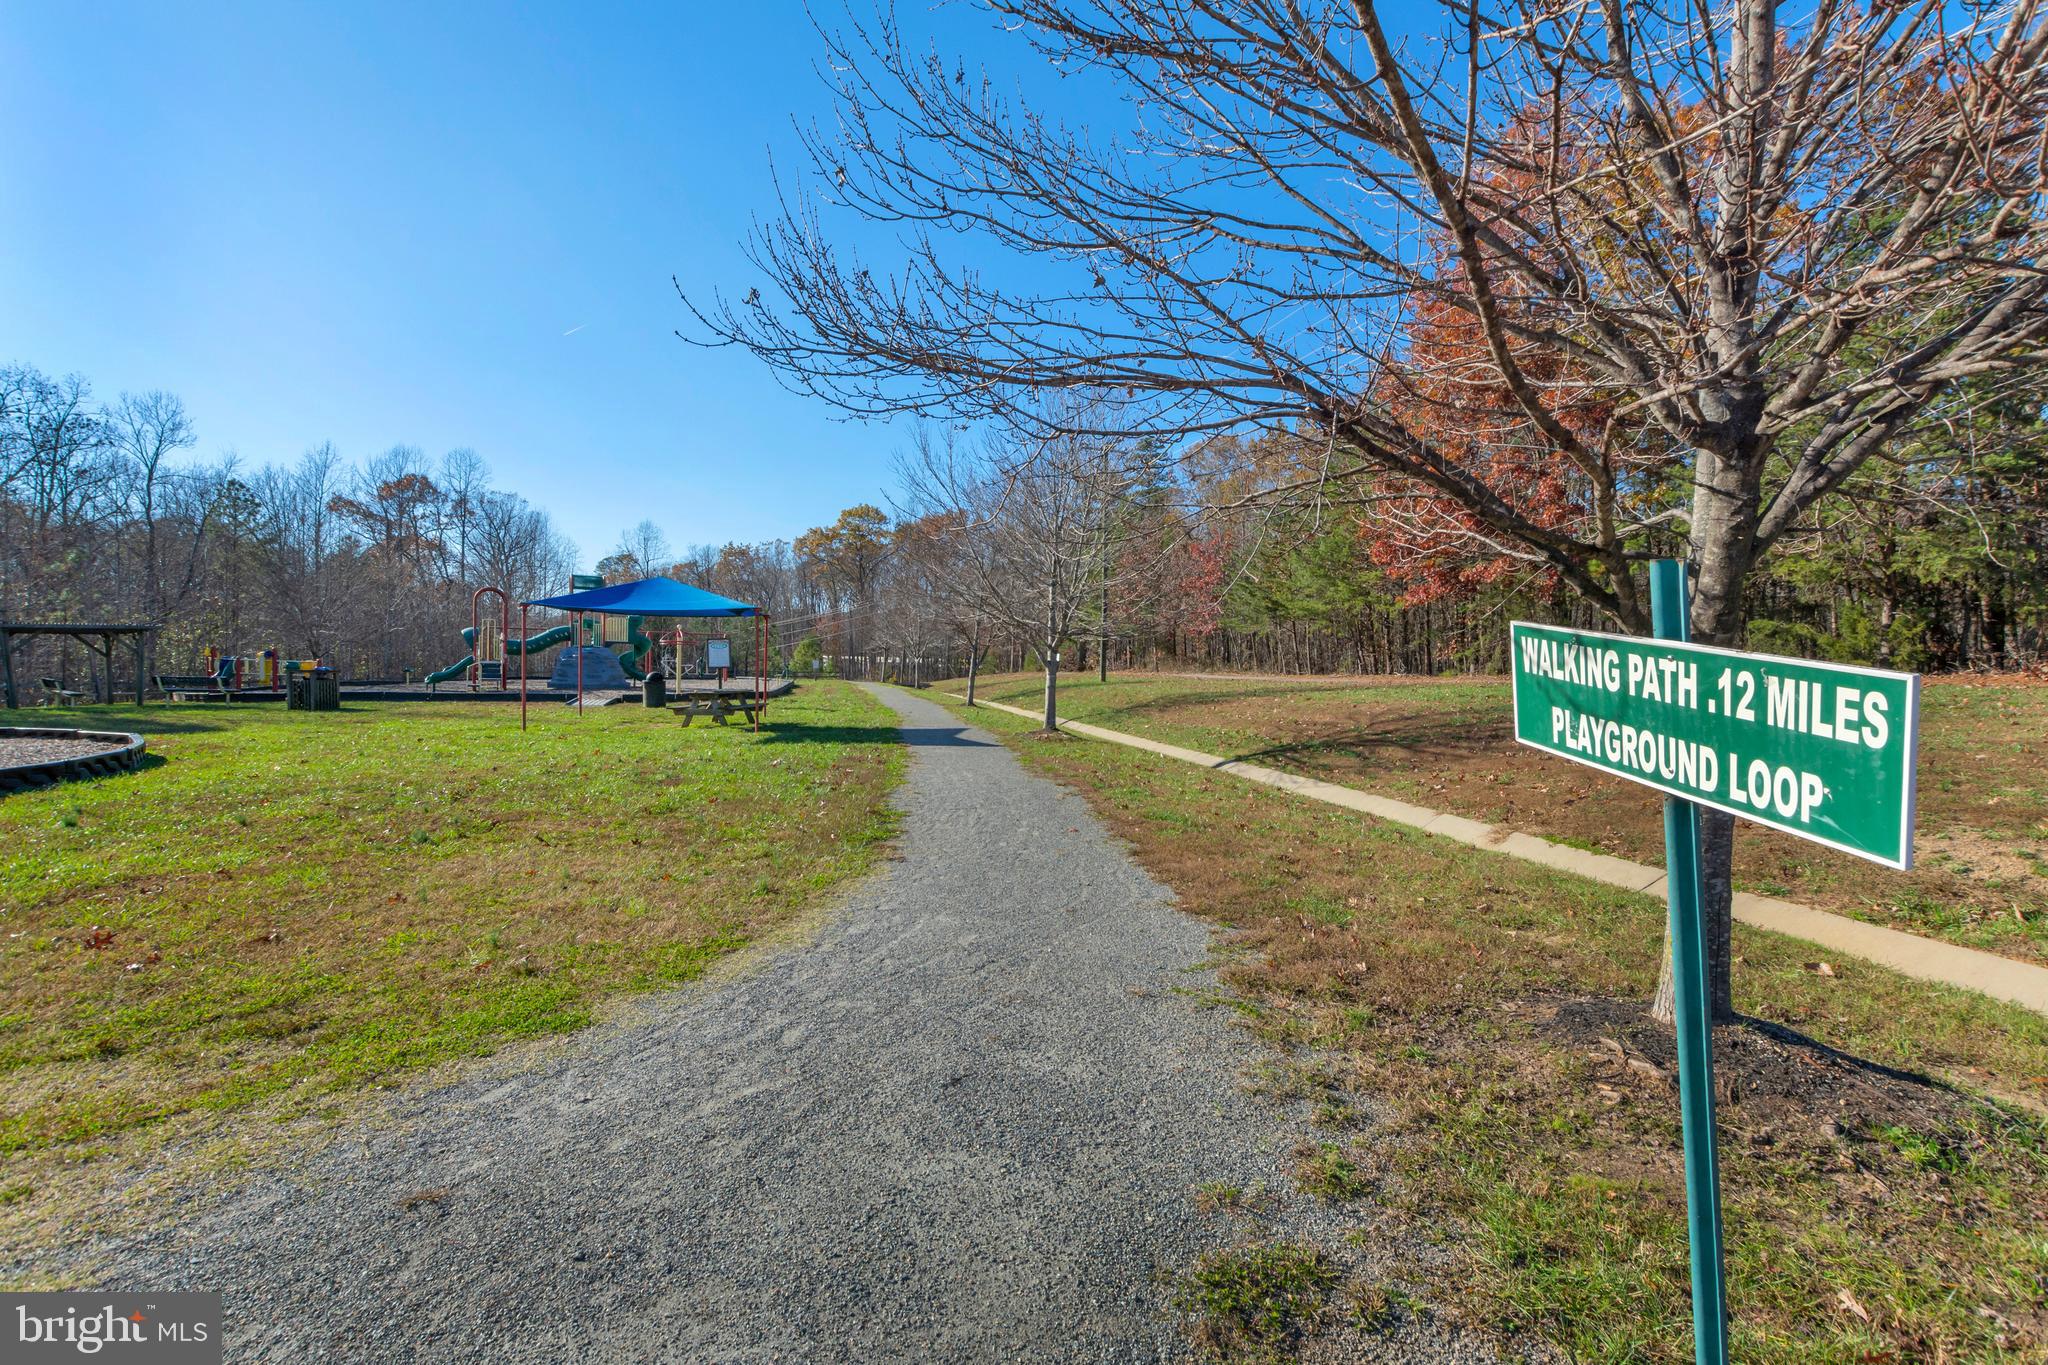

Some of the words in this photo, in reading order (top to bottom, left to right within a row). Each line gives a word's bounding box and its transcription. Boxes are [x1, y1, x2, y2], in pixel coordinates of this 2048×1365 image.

[1521, 635, 1621, 693] WALKING
[1628, 653, 1697, 711] PATH
[1708, 668, 1755, 722] .12
[1766, 675, 1889, 749] MILES
[1551, 706, 1719, 793] PLAYGROUND
[1729, 753, 1824, 824] LOOP
